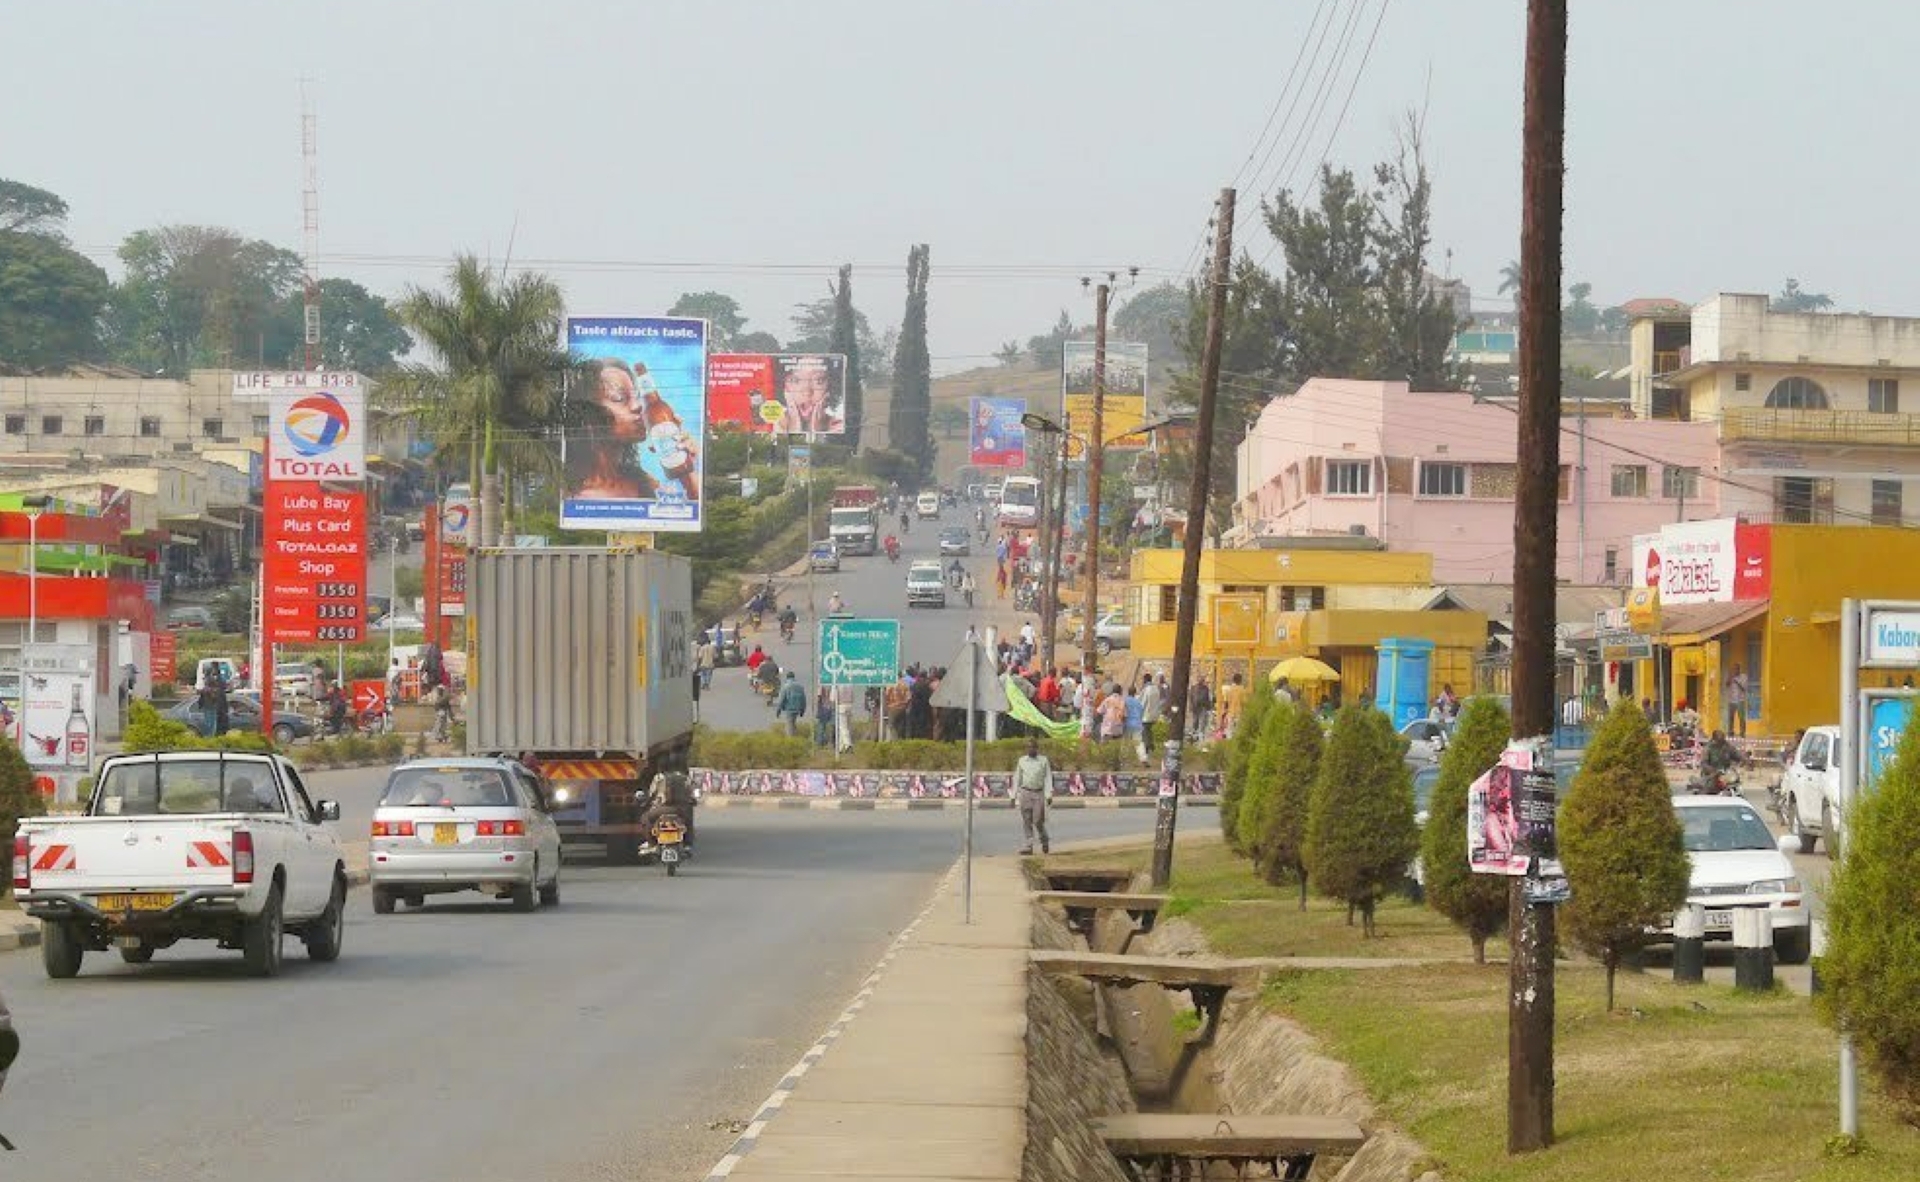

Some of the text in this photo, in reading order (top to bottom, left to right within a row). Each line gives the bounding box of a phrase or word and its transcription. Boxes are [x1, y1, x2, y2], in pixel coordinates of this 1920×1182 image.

[573, 325, 698, 338] Taste attracts taste.
[236, 374, 271, 388] LIFE
[284, 374, 307, 388] FM
[274, 458, 358, 476] TOTAL
[283, 495, 351, 512] Lube Bay
[283, 518, 351, 532] Plus Card
[299, 559, 335, 577] Shop
[319, 583, 356, 597] 3550
[274, 604, 356, 618] Diesel 3350
[317, 626, 356, 640] 2650
[1878, 623, 1920, 648] Kabar
